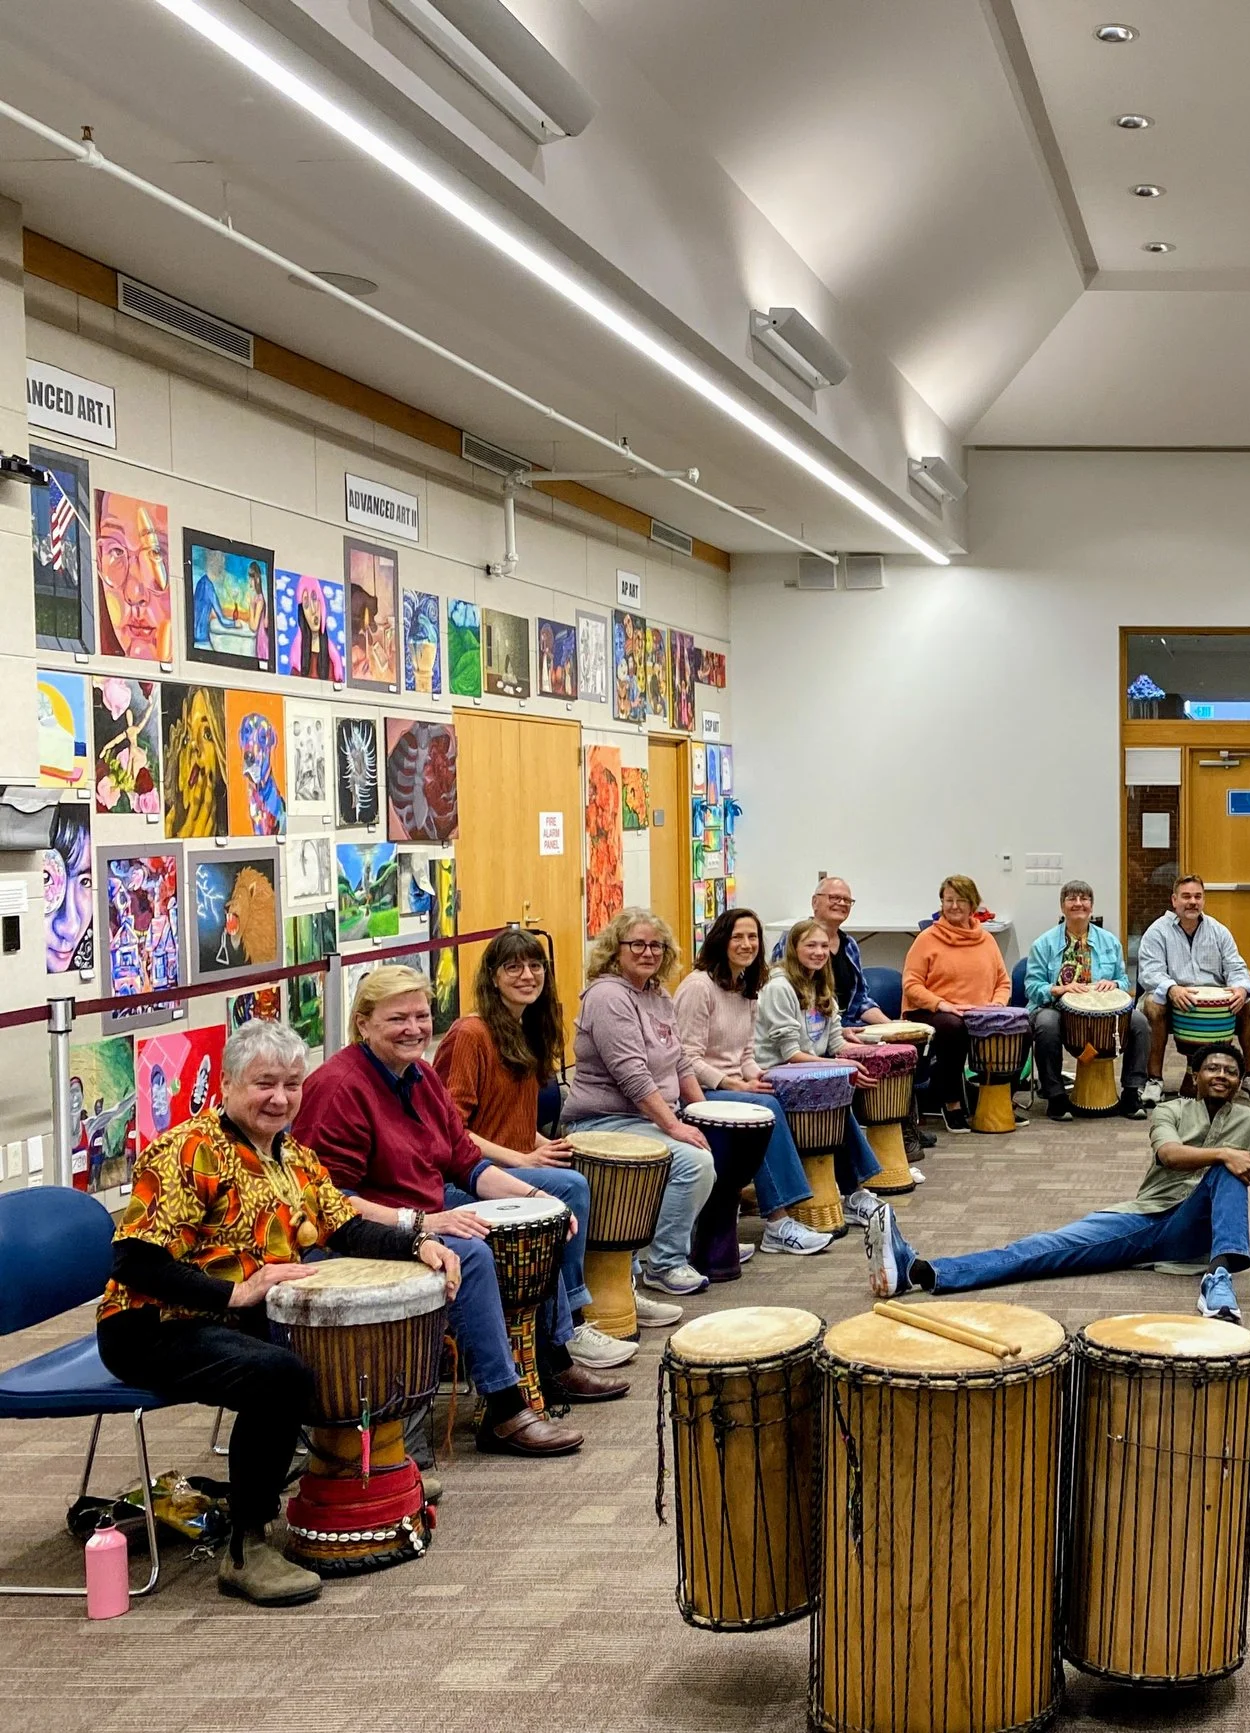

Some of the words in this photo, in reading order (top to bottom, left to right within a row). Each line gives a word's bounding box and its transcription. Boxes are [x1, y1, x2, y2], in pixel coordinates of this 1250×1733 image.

[77, 394, 103, 426] ART
[106, 404, 111, 428] I
[349, 488, 395, 520] ADVANCED
[396, 504, 410, 525] ART
[412, 509, 417, 528] II
[629, 582, 638, 599] ART
[546, 816, 556, 827] FIRE
[543, 828, 559, 838] ALARM
[544, 840, 559, 849] PANEL
